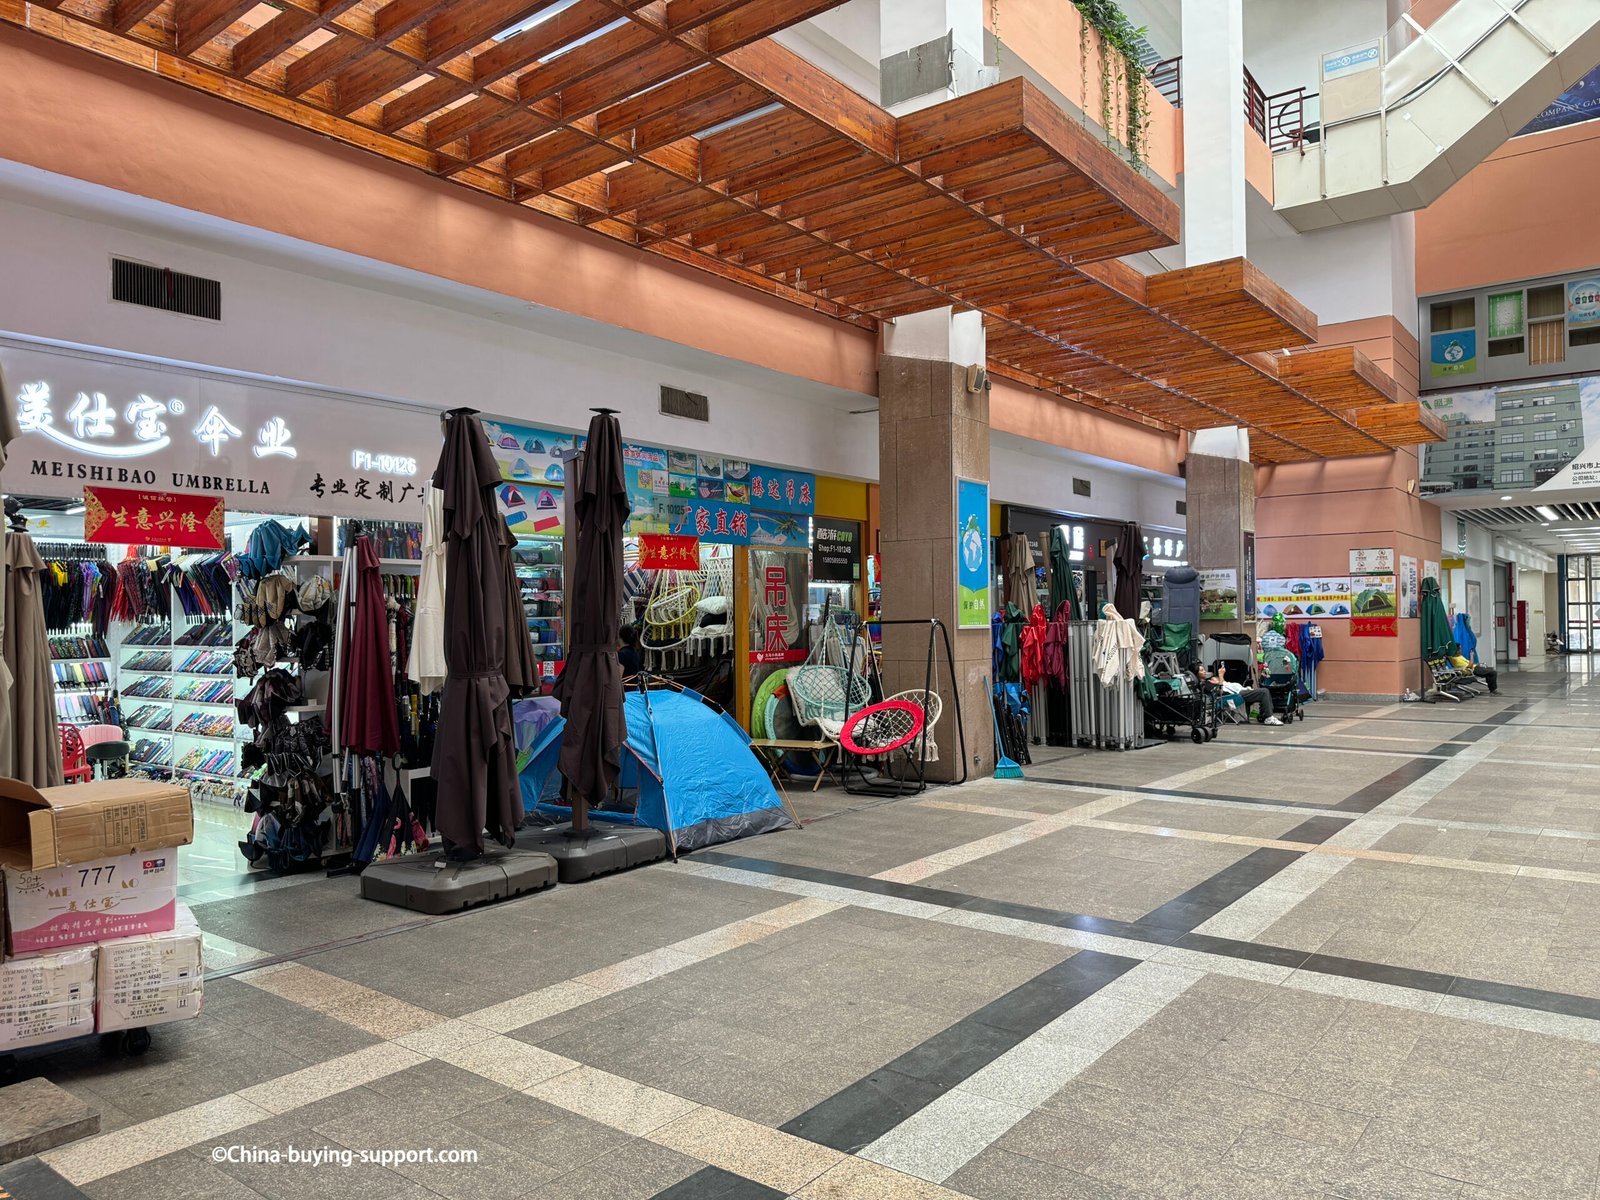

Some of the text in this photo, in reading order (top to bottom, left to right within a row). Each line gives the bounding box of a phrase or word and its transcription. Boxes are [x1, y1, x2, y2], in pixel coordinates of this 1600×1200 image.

[30, 459, 271, 494] MEISHIBAO UMBRELLA
[352, 449, 418, 476] F1-10126
[751, 476, 812, 506] 腾达吊床
[111, 505, 202, 533] 生意兴隆
[667, 504, 685, 515] 10125
[674, 505, 748, 538] 厂家直销
[650, 544, 690, 561] 生意兴隆
[764, 566, 789, 652] 吊床
[78, 865, 116, 888] 777
